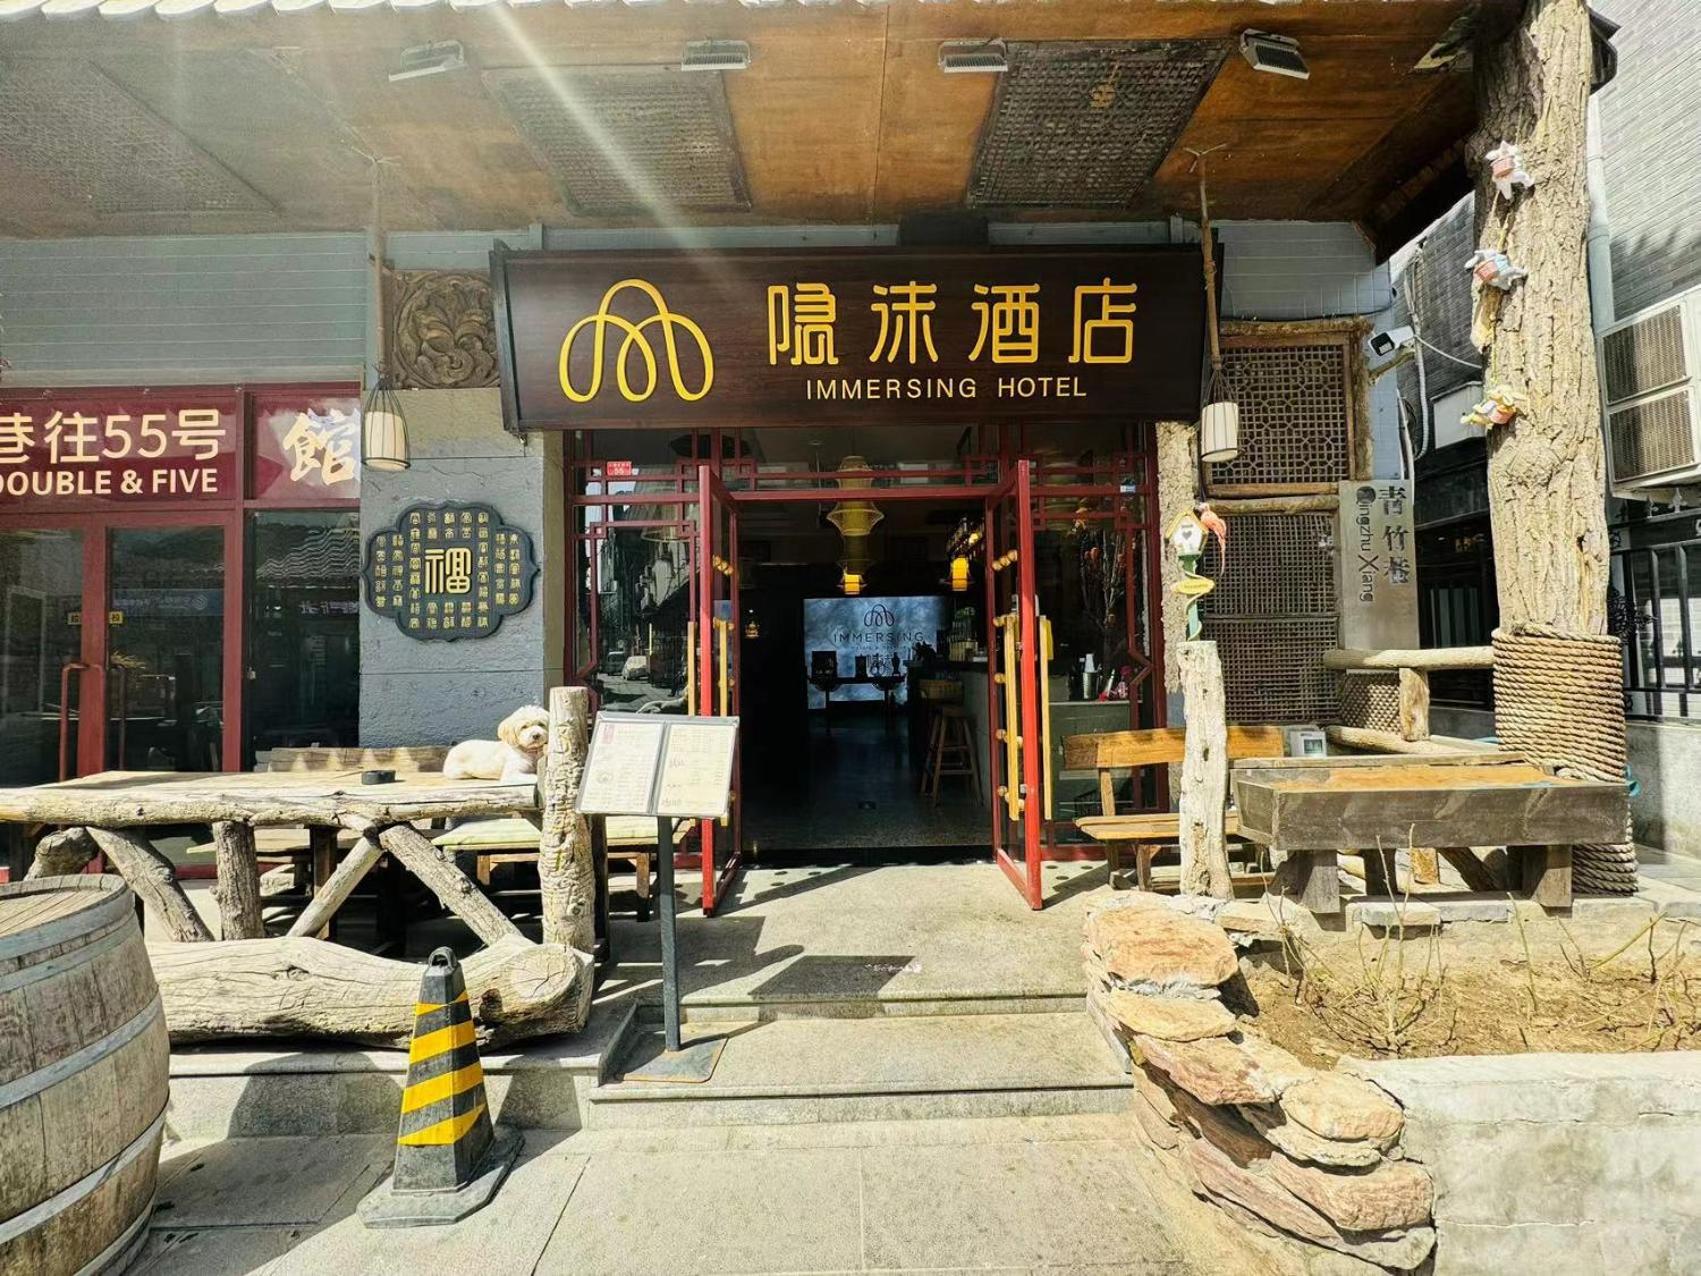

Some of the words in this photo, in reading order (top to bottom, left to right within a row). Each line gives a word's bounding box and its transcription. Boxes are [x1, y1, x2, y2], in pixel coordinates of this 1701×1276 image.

[767, 277, 1138, 366] 隐沫酒店
[806, 378, 976, 400] IMMERSING
[998, 377, 1087, 398] HOTEL
[0, 470, 112, 496] OUBLE
[120, 469, 144, 495] &
[152, 469, 218, 494] FIVE
[1358, 554, 1380, 602] Xiang
[834, 632, 925, 643] IMMERSING
